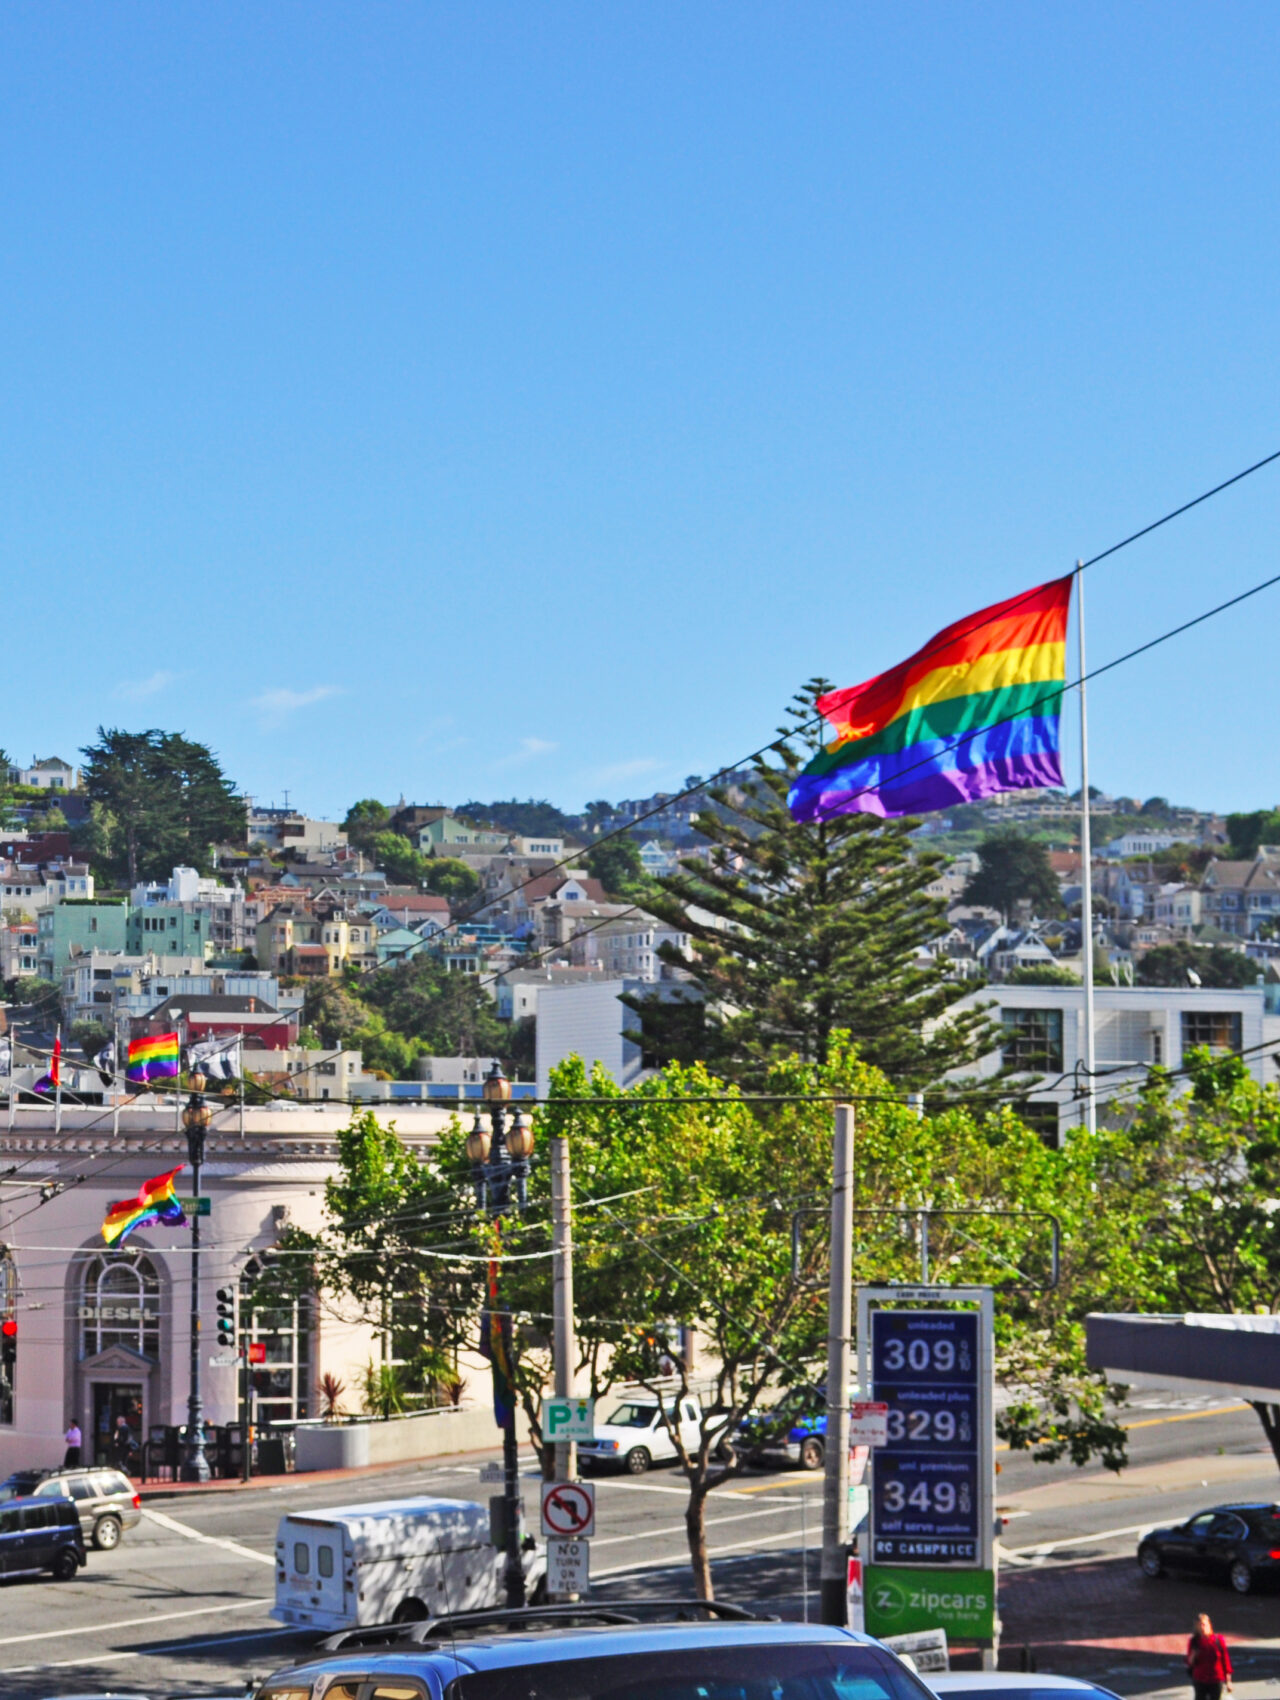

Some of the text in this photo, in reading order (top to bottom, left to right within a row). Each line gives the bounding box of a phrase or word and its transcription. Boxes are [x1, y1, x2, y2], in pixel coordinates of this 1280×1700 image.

[78, 1306, 157, 1320] DIESEL
[906, 1320, 956, 1331] unleaded
[883, 1338, 956, 1371] 309
[896, 1390, 971, 1403] unleaded plus
[886, 1409, 957, 1442] 329
[920, 1462, 970, 1473] premium
[883, 1480, 957, 1514] 349
[881, 1520, 903, 1532] self
[905, 1522, 935, 1533] serve
[558, 1544, 580, 1556] NO
[877, 1541, 893, 1554] RC
[555, 1557, 581, 1568] TURN
[560, 1568, 576, 1580] ON
[909, 1588, 987, 1614] zipcars
[956, 1609, 980, 1621] here
